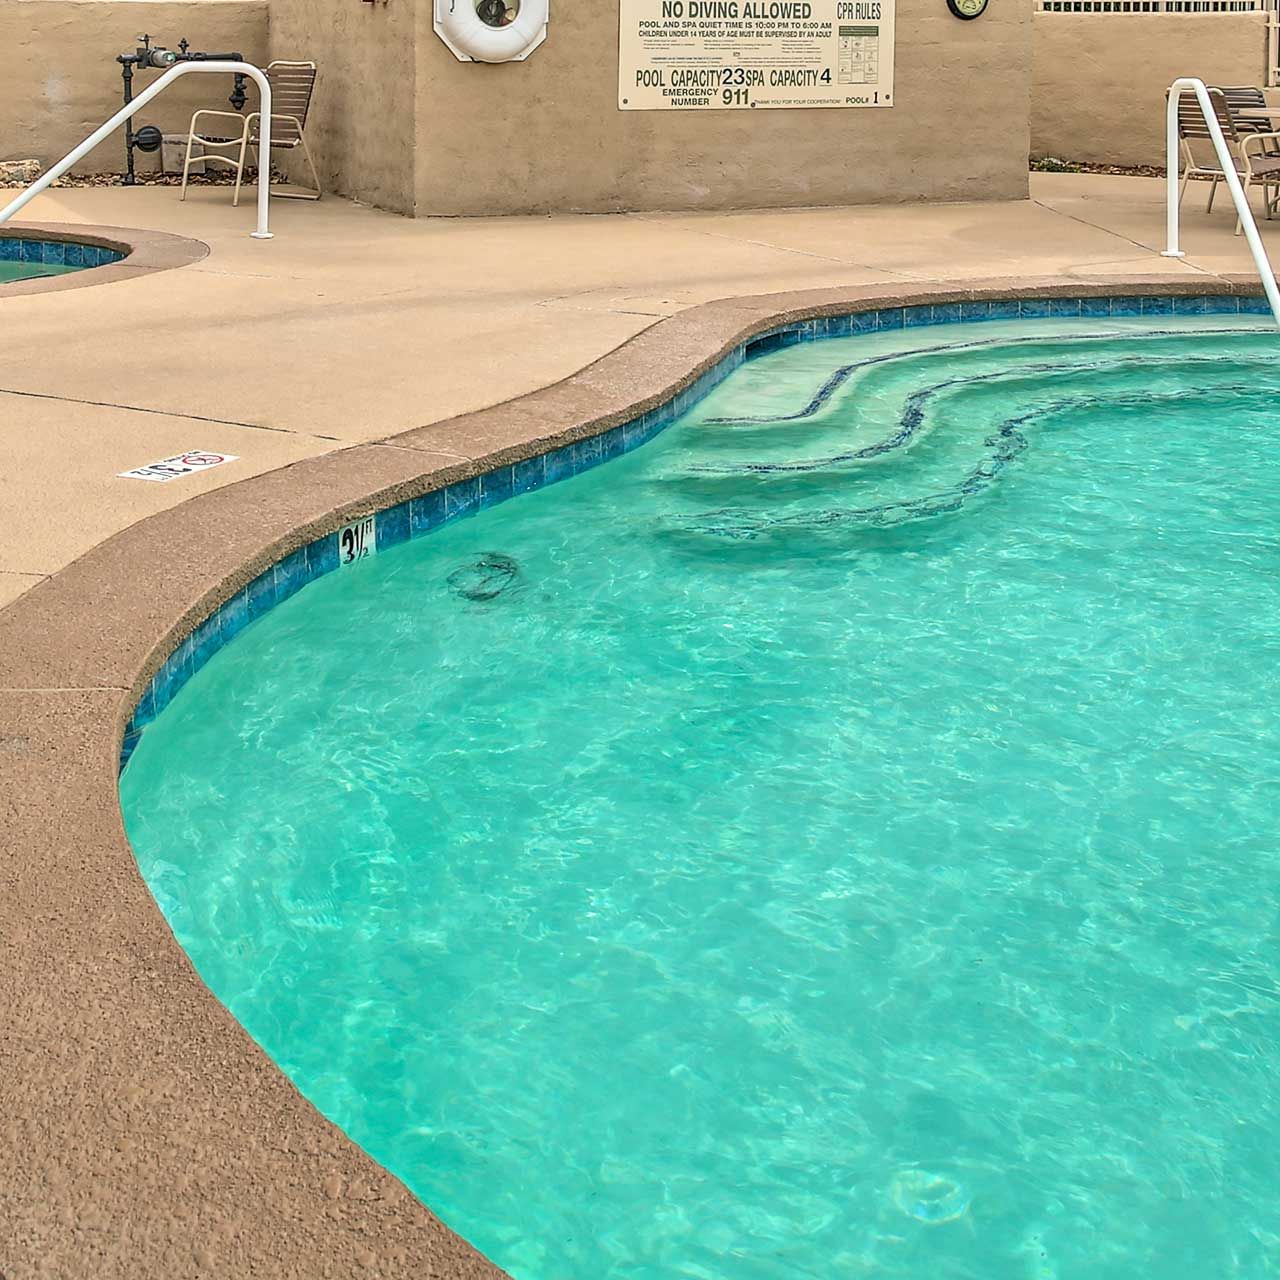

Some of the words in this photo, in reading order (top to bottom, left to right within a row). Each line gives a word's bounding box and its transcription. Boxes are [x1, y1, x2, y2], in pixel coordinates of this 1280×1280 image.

[662, 0, 684, 18] NO
[688, 1, 739, 19] DIVING
[742, 2, 812, 19] ALLOWED
[836, 1, 854, 20] CPR
[855, 2, 882, 20] RULES
[636, 70, 666, 87] POOL
[671, 70, 722, 87] CAPACITY
[722, 68, 745, 85] 23
[745, 70, 765, 87] SPA
[770, 70, 818, 87] CAPACITY
[820, 68, 832, 84] 4
[662, 88, 719, 96] EMERGENCY
[722, 88, 749, 105] 911
[873, 91, 879, 104] 1
[671, 98, 710, 106] NUMBER
[365, 518, 373, 534] FT
